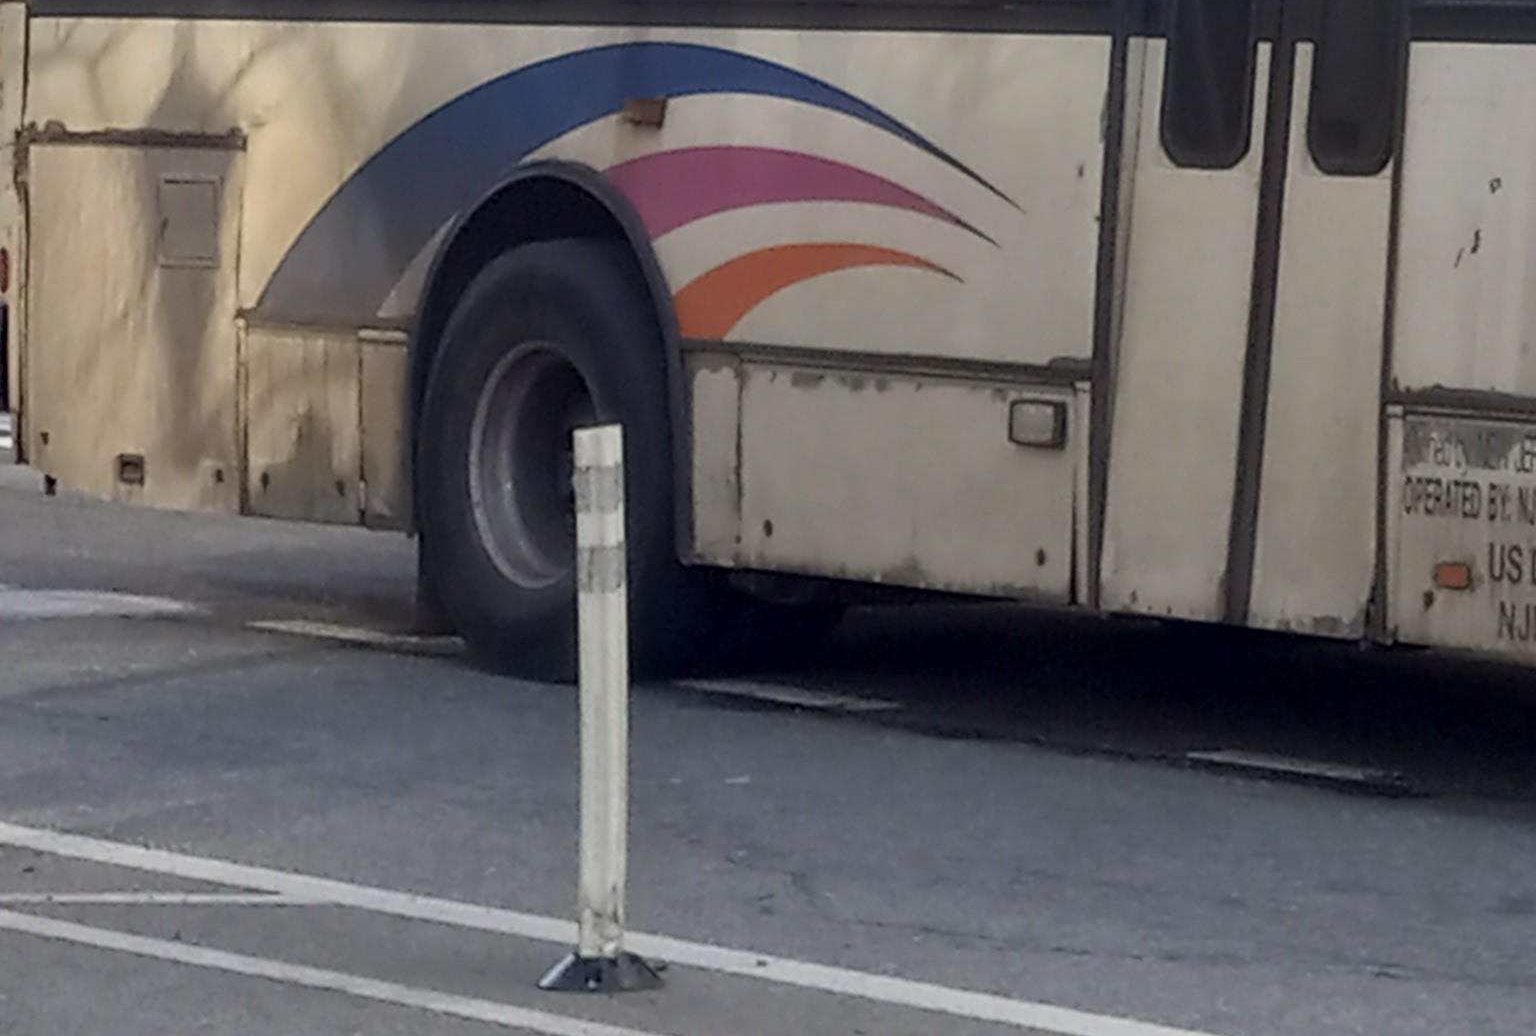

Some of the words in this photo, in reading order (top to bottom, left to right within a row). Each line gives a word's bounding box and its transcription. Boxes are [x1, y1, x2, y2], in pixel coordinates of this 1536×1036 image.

[1404, 475, 1481, 520] OPERATED
[1517, 487, 1536, 526] NJ
[1489, 543, 1523, 585] US
